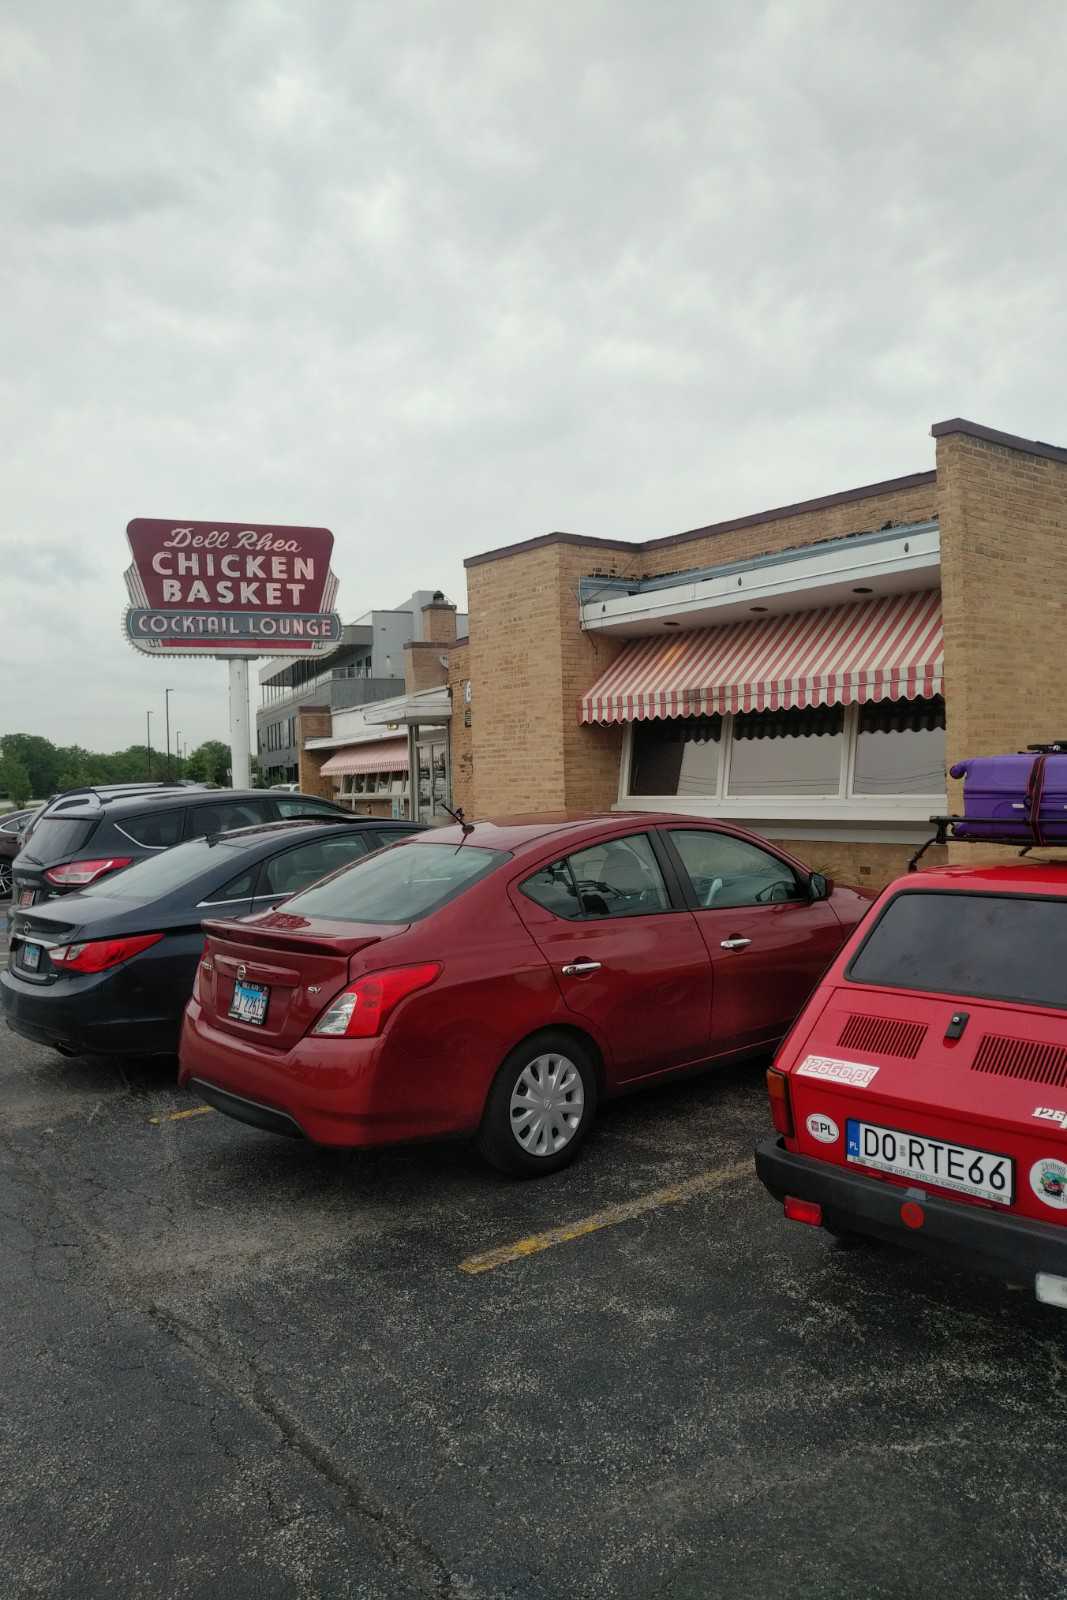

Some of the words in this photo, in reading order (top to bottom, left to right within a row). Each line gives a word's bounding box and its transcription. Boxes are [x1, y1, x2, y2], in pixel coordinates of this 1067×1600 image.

[163, 527, 230, 549] Dell
[232, 530, 303, 553] Rhea
[152, 551, 314, 580] CHICKEN
[162, 578, 306, 606] BASKET
[138, 615, 240, 634] COCKTAIL
[250, 617, 332, 636] LOUNGE
[820, 1122, 836, 1137] PL
[849, 1140, 859, 1151] PL
[908, 1138, 1006, 1191] RTE66
